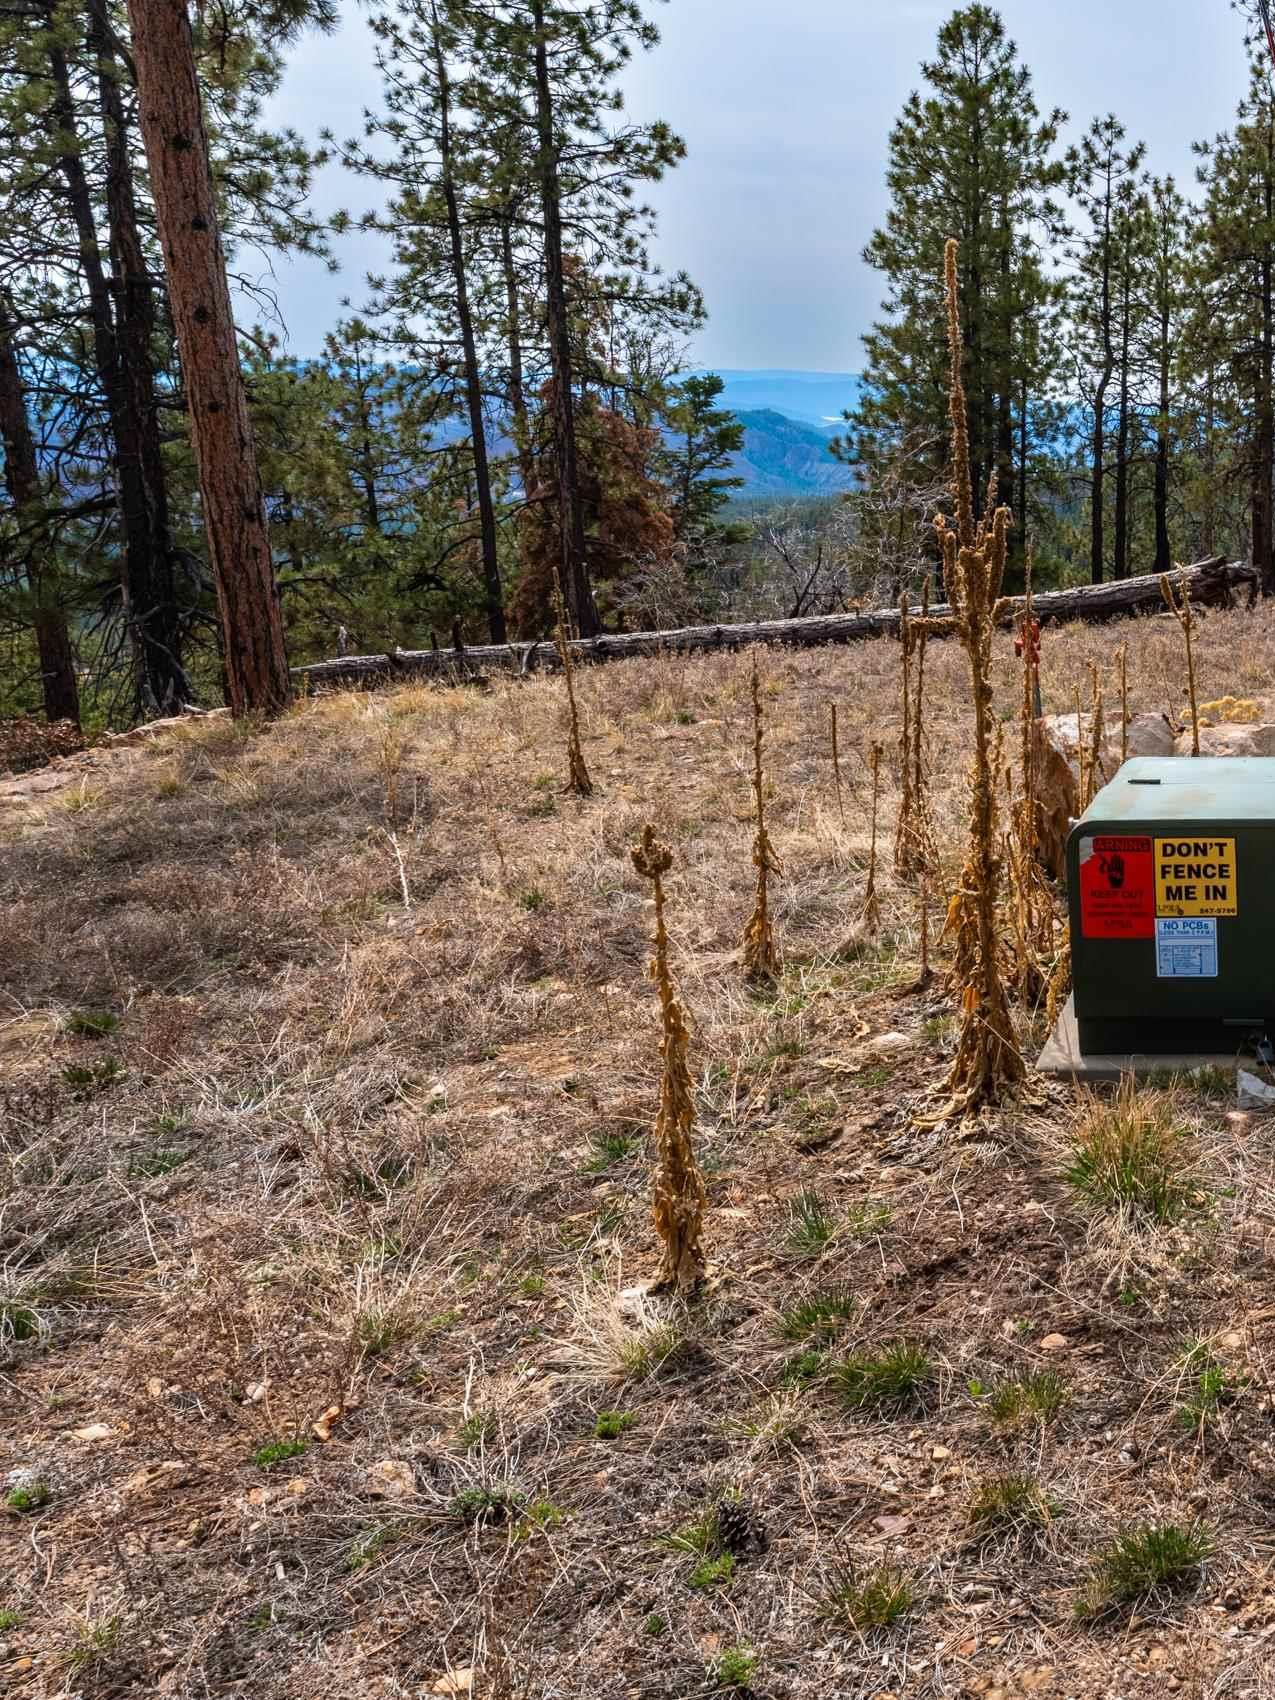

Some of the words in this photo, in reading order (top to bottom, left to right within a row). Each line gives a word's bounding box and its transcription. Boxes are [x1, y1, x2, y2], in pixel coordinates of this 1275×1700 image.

[1094, 838, 1149, 850] ARNING
[1162, 842, 1228, 857] DON'T
[1160, 863, 1231, 879] FENCE
[1165, 885, 1197, 901] ME
[1204, 885, 1227, 901] IN
[1163, 921, 1179, 930] NO
[1182, 921, 1209, 930] PCBs
